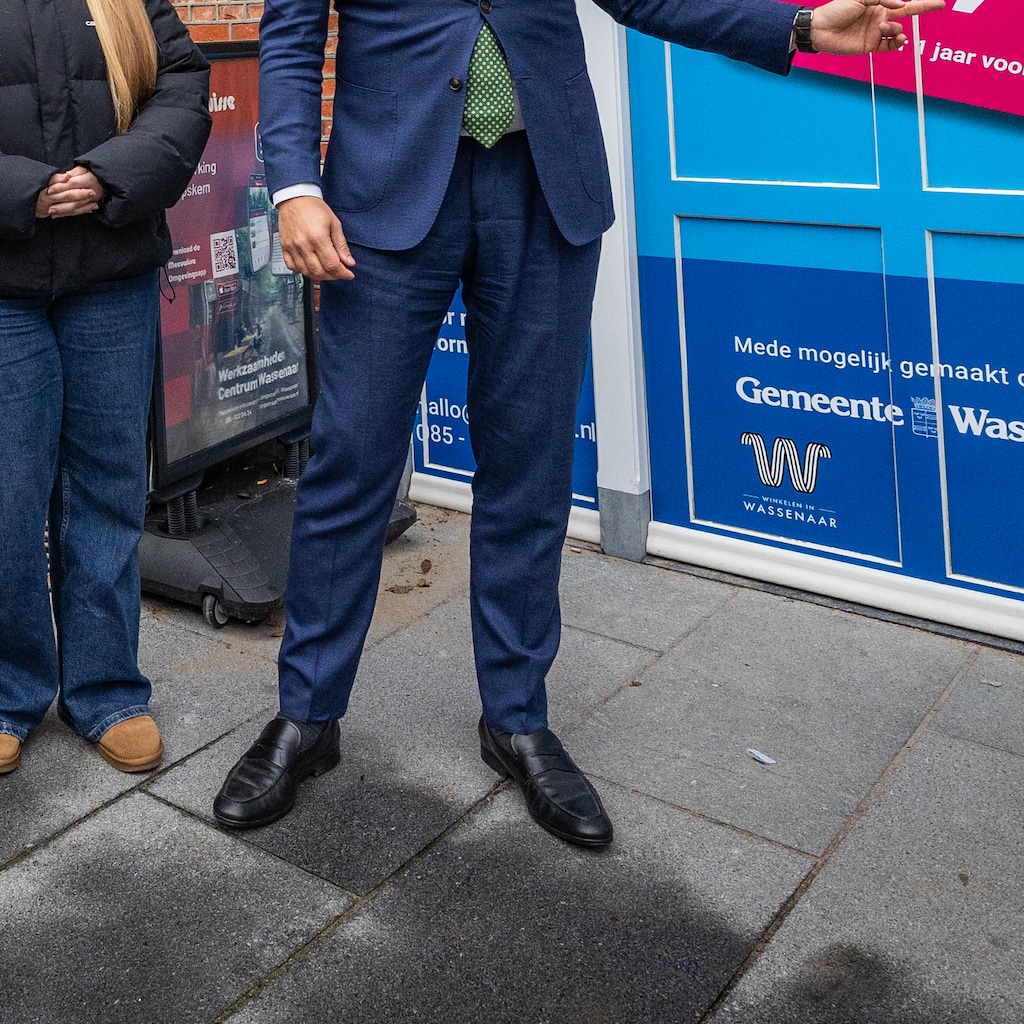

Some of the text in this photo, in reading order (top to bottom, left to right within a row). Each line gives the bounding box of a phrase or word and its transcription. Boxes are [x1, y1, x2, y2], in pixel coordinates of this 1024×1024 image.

[929, 41, 977, 65] jaar
[981, 54, 1024, 76] voo
[734, 335, 792, 358] Mede
[798, 345, 893, 373] mogelijk
[899, 360, 1010, 386] gemaakt
[218, 379, 258, 400] Centrum
[258, 362, 299, 387] Wassenaar
[735, 376, 905, 426] Gemeente
[416, 423, 454, 445] 085
[742, 500, 838, 528] WASSENAAR
[761, 495, 803, 509] WINKELEN
